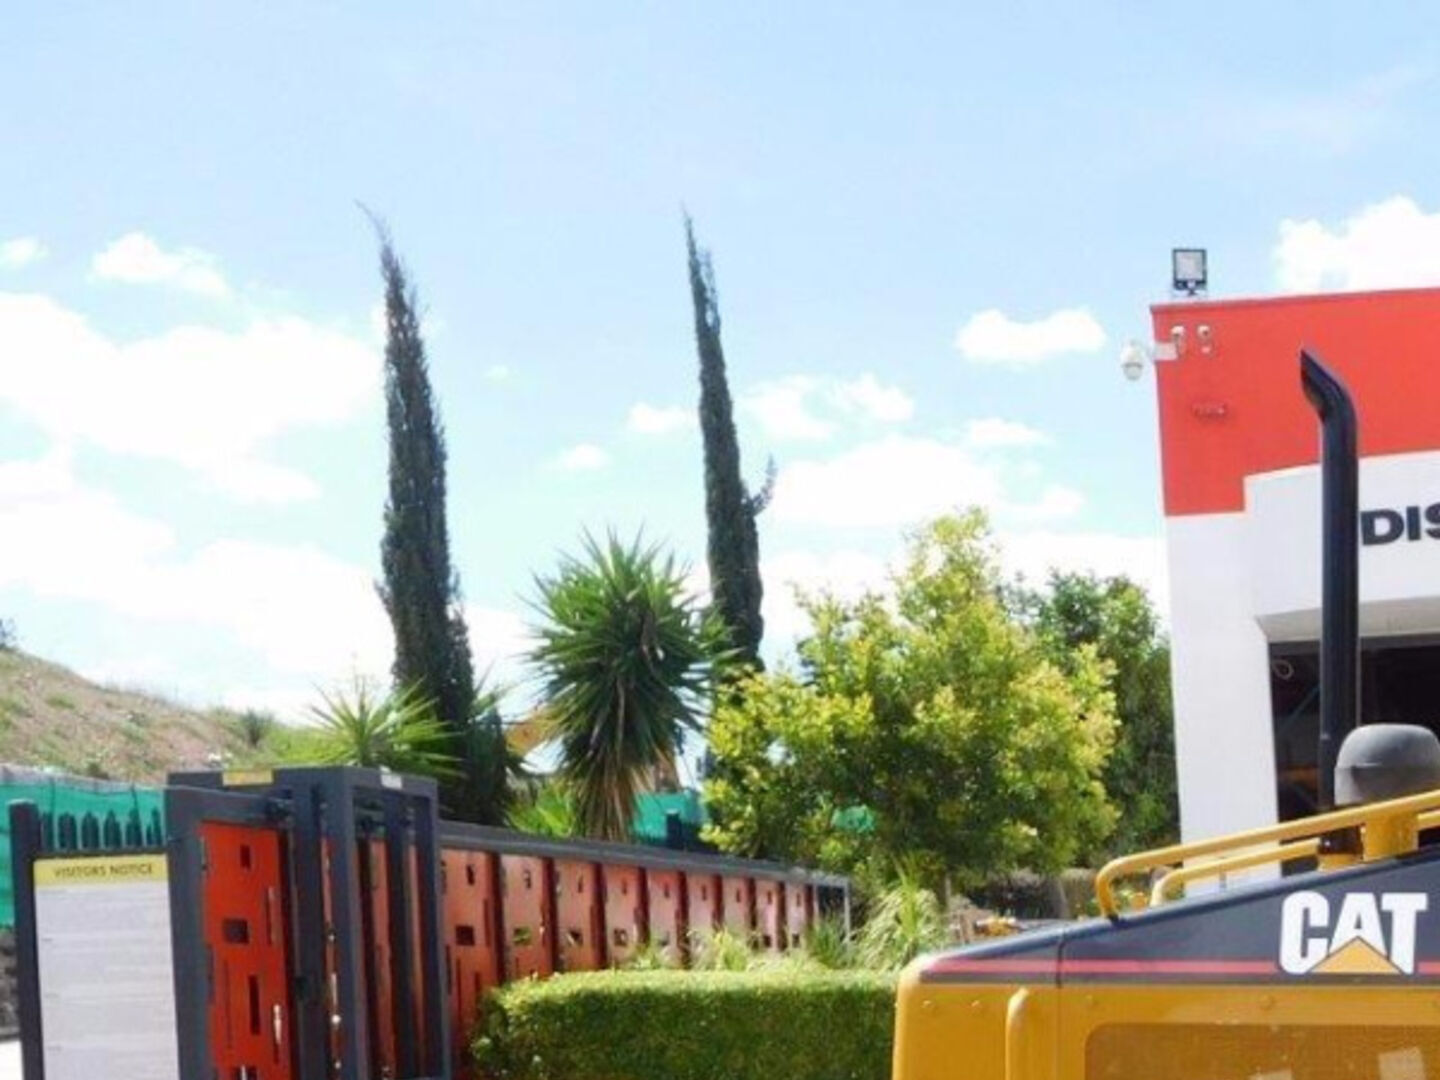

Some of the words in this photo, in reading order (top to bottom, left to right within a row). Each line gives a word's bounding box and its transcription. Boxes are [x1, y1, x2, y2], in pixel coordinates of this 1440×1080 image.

[53, 865, 107, 878] VISITORS
[109, 863, 154, 876] NOTICE
[1279, 890, 1428, 976] CAT
